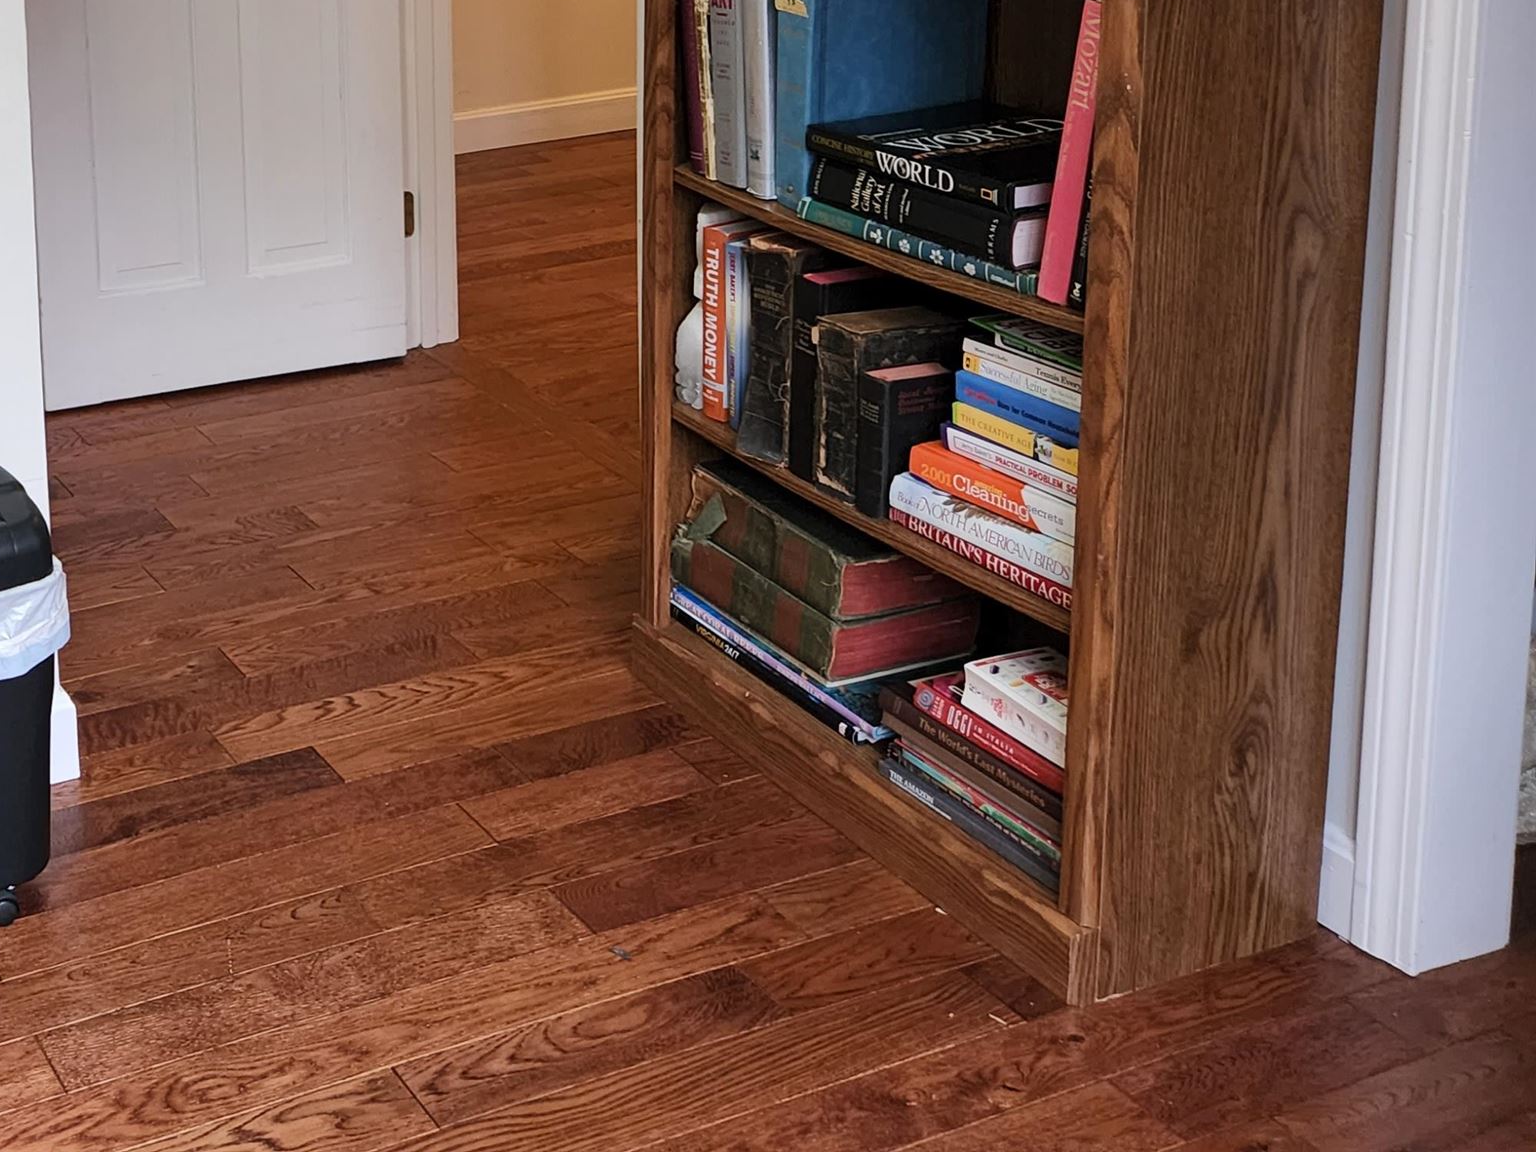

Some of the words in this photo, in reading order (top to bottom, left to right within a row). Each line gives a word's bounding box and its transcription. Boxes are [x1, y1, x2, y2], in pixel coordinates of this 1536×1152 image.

[1072, 11, 1101, 110] Mozart
[881, 119, 1064, 152] WORLD
[851, 168, 867, 210] National
[875, 150, 955, 192] WORLD
[861, 176, 877, 212] Gallery
[872, 200, 882, 214] of
[874, 184, 886, 202] Art
[705, 248, 719, 307] TRUTH
[704, 311, 718, 380] MONEY
[1035, 367, 1060, 381] Tennis
[960, 413, 975, 425] THE
[977, 418, 1014, 442] CREATIVE
[995, 455, 1026, 475] PRACTICAL
[1027, 468, 1063, 489] PROBLEM
[952, 474, 1030, 522] Cleaning
[1028, 505, 1064, 527] secrets
[897, 491, 913, 508] Book
[922, 496, 967, 531] NORTH
[968, 522, 1032, 562] AMERICAN
[1034, 552, 1071, 581] BIRDS
[908, 515, 983, 565] BRITAIN'S
[985, 554, 1072, 610] HERITAGE
[946, 705, 973, 737] OGGI
[918, 717, 937, 736] The
[938, 727, 974, 759] World's
[974, 754, 996, 776] Last
[996, 765, 1046, 808] Mysteries
[903, 776, 934, 805] AMAZON
